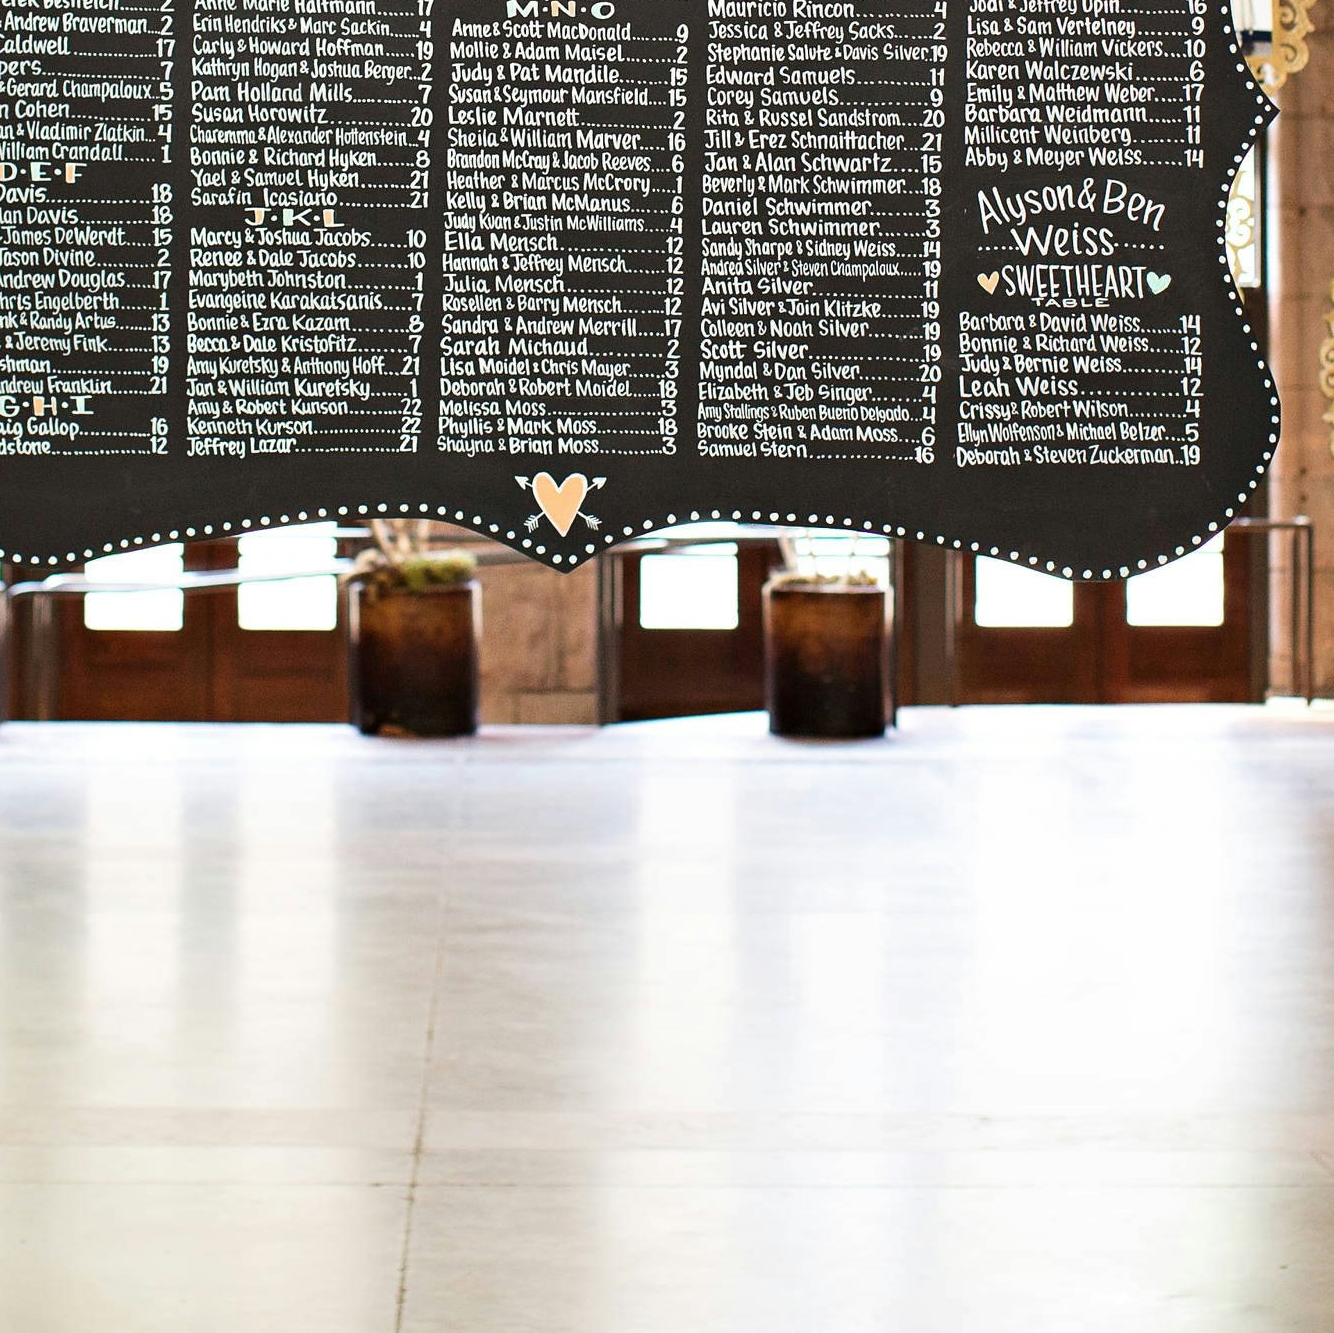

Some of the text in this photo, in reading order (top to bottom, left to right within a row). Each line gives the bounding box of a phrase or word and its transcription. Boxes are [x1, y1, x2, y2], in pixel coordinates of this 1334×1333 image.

[933, 0, 948, 20] 4
[155, 37, 176, 58] 17
[705, 63, 945, 87] Edward Samuels 11
[965, 59, 1206, 82] Karen Walczewski 6
[190, 79, 433, 105] Pam Holland Mills 7
[14, 99, 70, 119] Cohen
[151, 103, 173, 122] 15
[191, 102, 434, 128] Susan Horowitz 20
[447, 103, 686, 131] Leslie Marnett 2
[964, 100, 1201, 124] Barbara Weidmann 11
[964, 123, 1201, 147] Millicent Weinberg 11
[150, 183, 173, 204] 18
[190, 186, 253, 207] Sarafin
[406, 190, 429, 209] 21
[446, 190, 684, 217] Kelly & Brian McManus 6
[702, 196, 941, 218] Daniel Schwimmer 3
[977, 177, 1166, 238] Alyson & Ben
[444, 230, 684, 256] Ella Mensch 12
[1010, 221, 1115, 257] Weiss
[188, 268, 424, 292] Marybeth Johnston 1
[701, 276, 939, 299] Anita Silver 11
[1001, 263, 1147, 299] SWEETHEART
[1031, 296, 1110, 308] TABLE
[439, 335, 681, 360] Sarah Michaud 2
[150, 355, 170, 375] 19
[958, 353, 1203, 377] Judy & Bernie Weiss 14
[958, 374, 1205, 398] Leah Weiss 12
[439, 398, 678, 417] Melissa Moss 3
[149, 435, 169, 455] 12
[186, 433, 418, 460] Jeffrey Lazar 21
[697, 439, 935, 465] Samuel Stern 16
[956, 444, 1201, 468] Deborah & Steven Zuckerman 19
